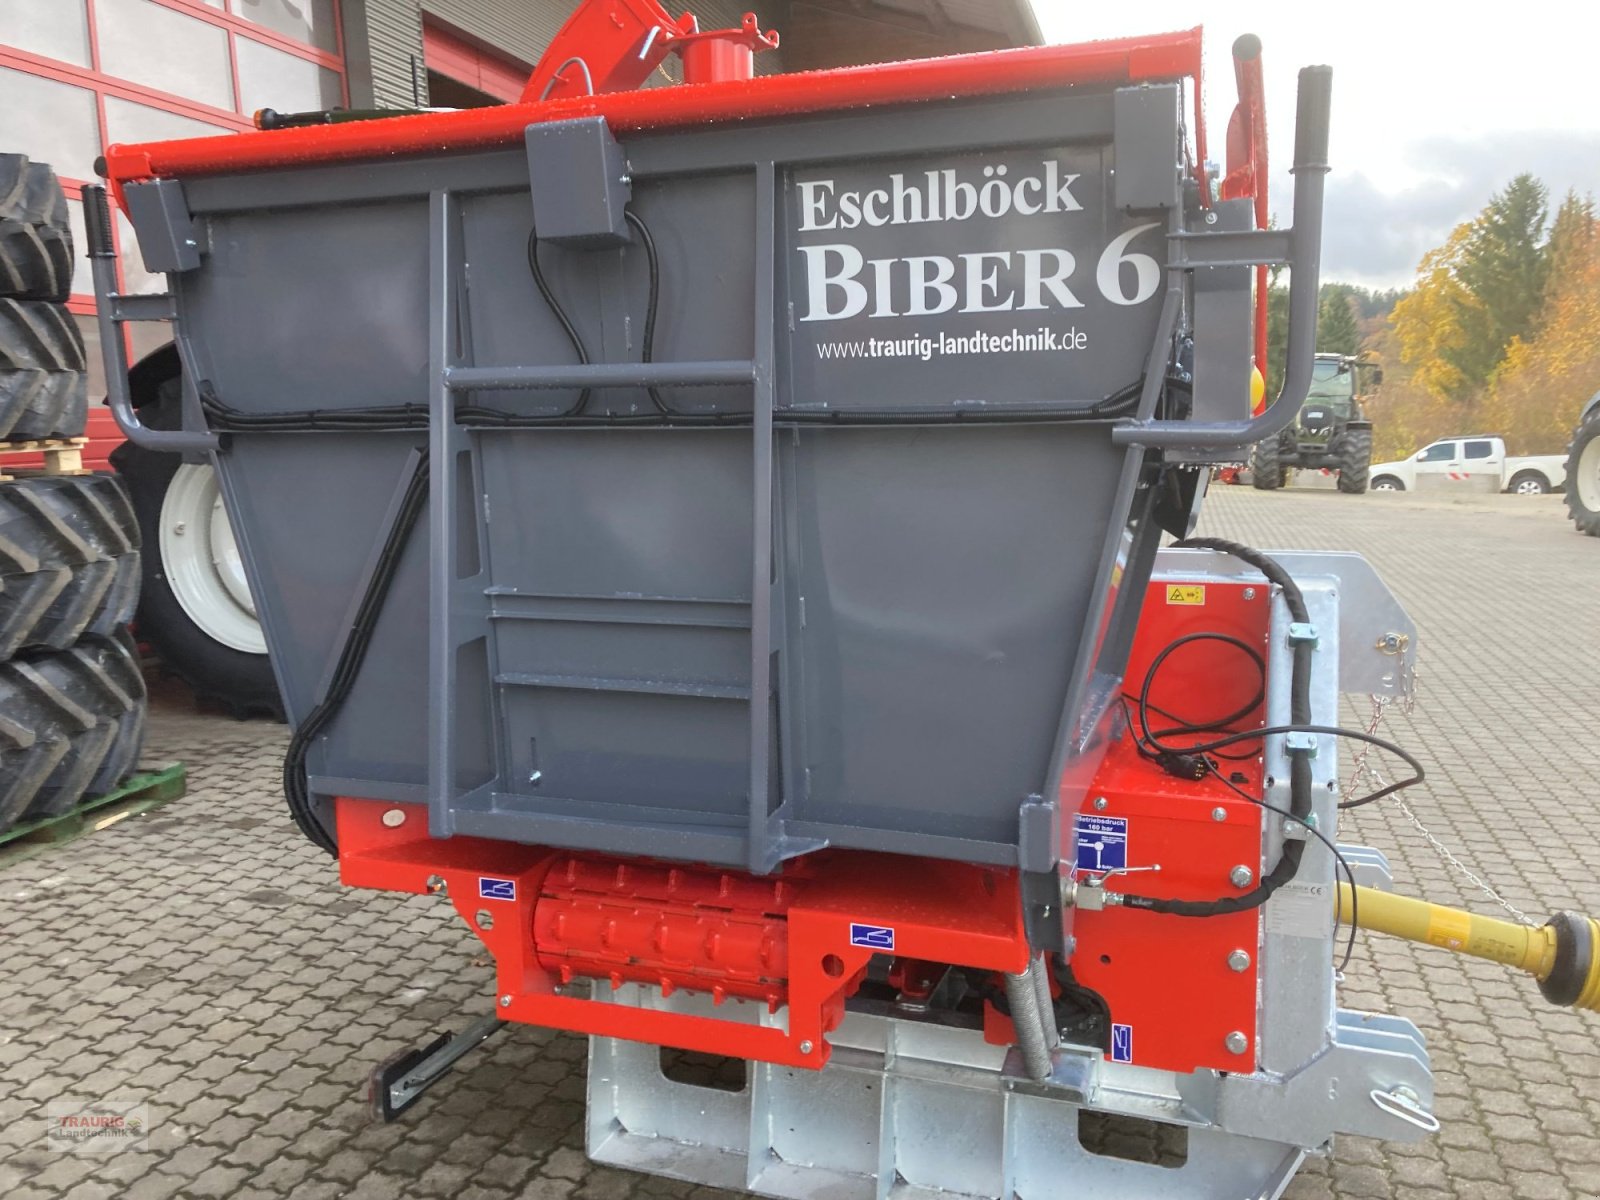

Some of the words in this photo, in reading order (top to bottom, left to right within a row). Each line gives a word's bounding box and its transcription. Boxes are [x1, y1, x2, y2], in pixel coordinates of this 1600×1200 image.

[797, 160, 1083, 231] Eschlböck
[797, 244, 1085, 321] BIBER
[1096, 222, 1161, 306] 6
[816, 326, 1088, 360] www.traurig-landtechnik.de
